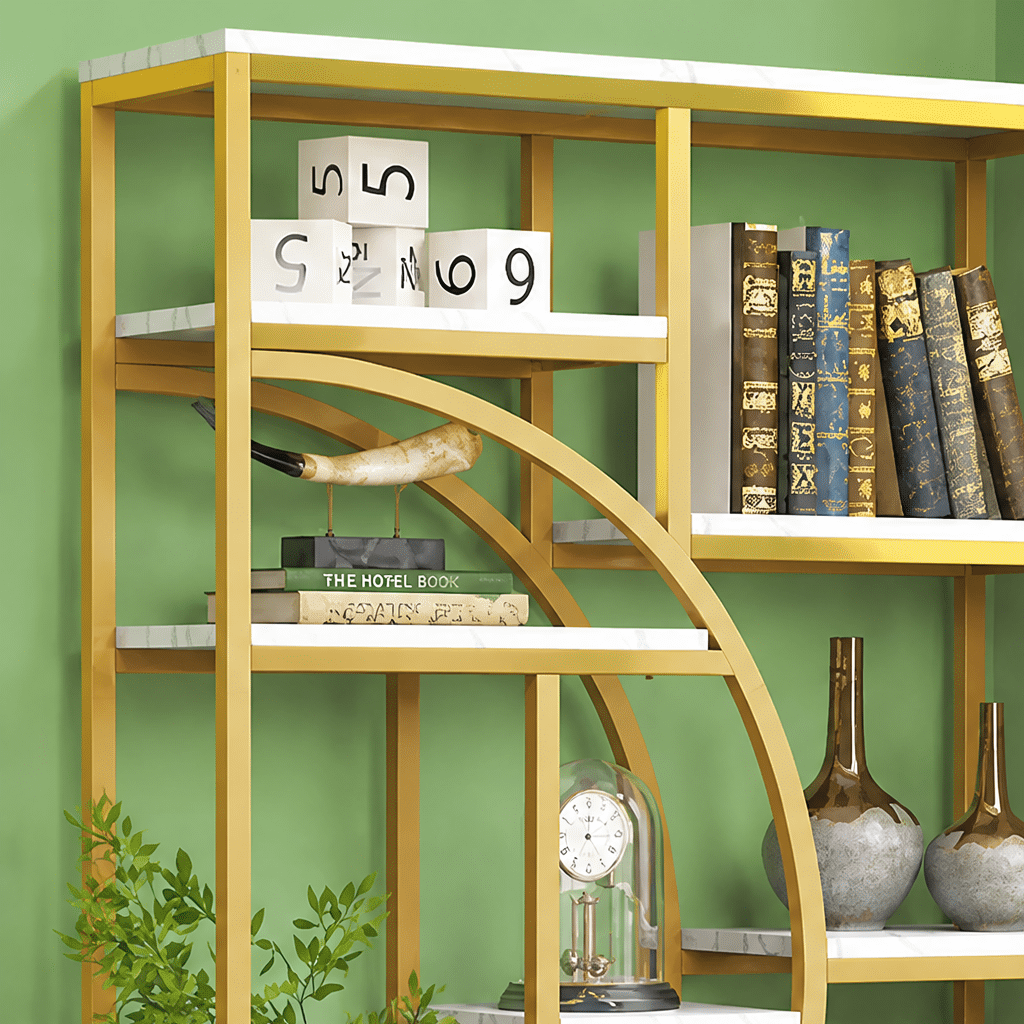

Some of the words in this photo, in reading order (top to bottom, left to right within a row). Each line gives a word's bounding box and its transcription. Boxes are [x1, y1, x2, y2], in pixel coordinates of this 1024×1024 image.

[311, 164, 343, 196] 5
[361, 162, 415, 201] 5
[504, 247, 535, 306] 9
[323, 573, 357, 588] THE
[361, 573, 413, 588] HOTEL
[416, 574, 460, 589] BOOK
